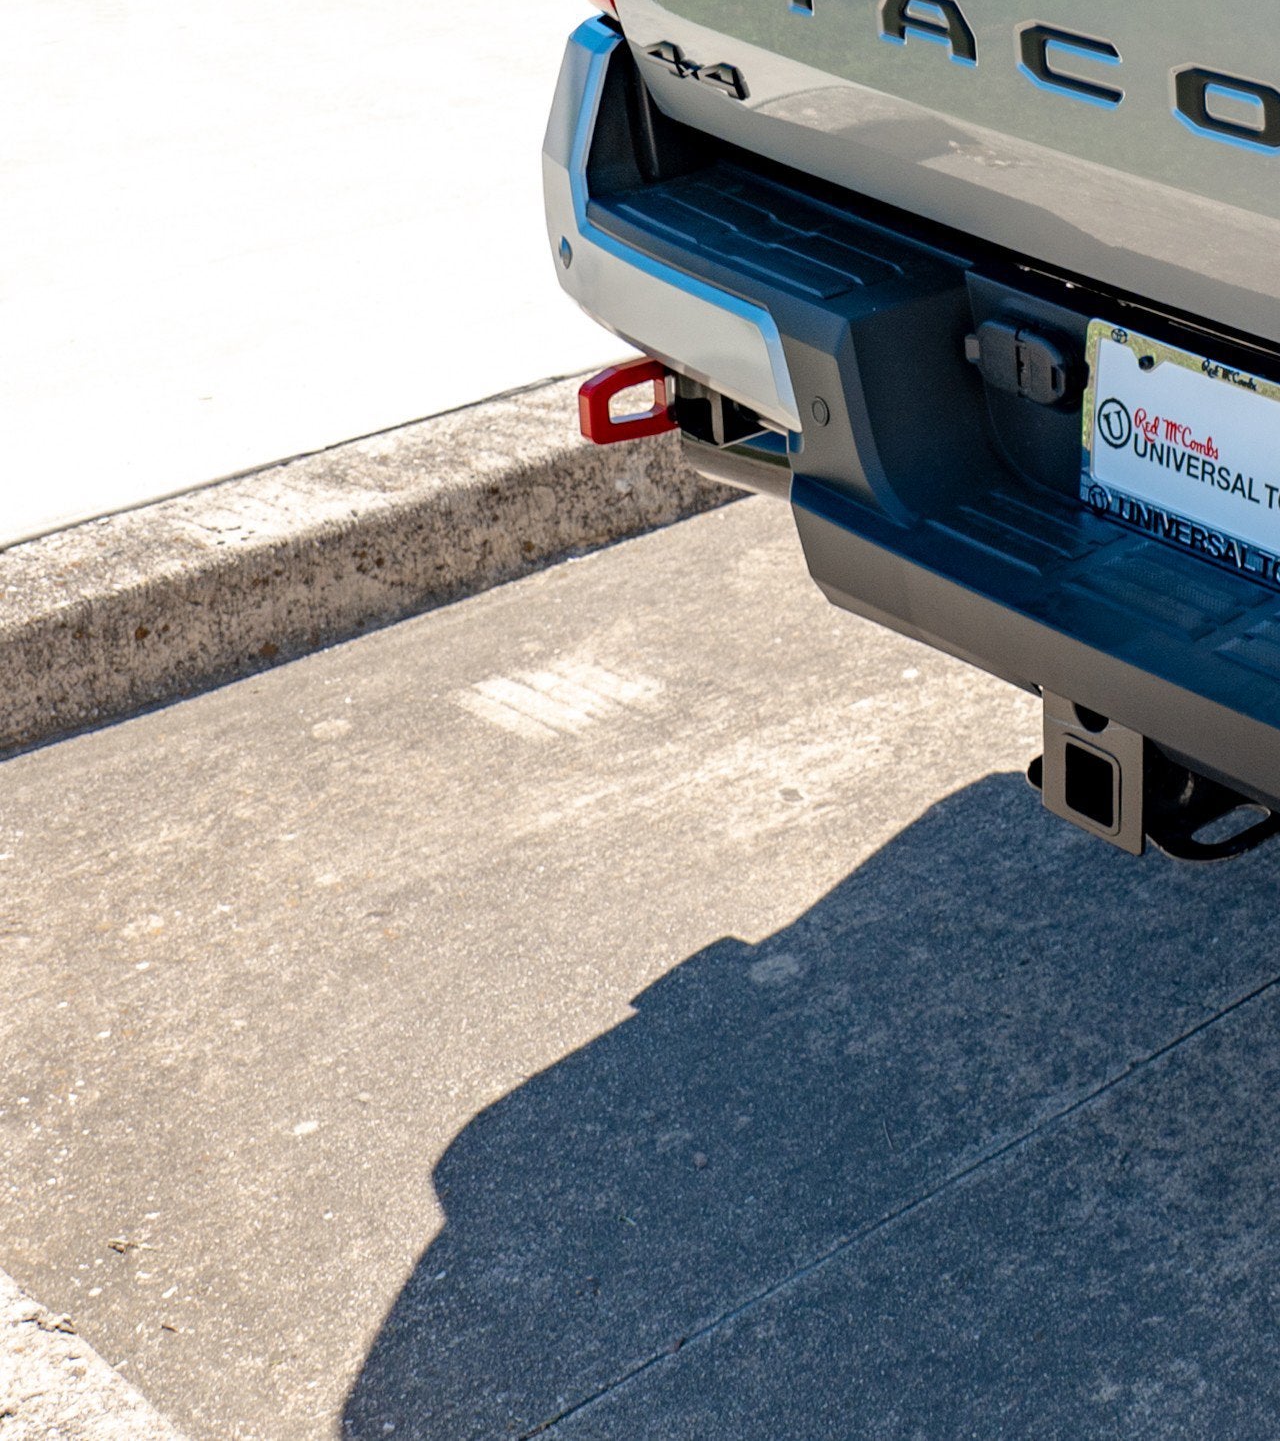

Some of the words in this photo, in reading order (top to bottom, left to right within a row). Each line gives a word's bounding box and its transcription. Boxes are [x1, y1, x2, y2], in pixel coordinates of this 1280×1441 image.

[1133, 432, 1261, 504] UNIVERSAL
[1134, 407, 1160, 444] Red
[1162, 417, 1219, 460] McCombs
[1117, 495, 1256, 573] UNIVERSAL
